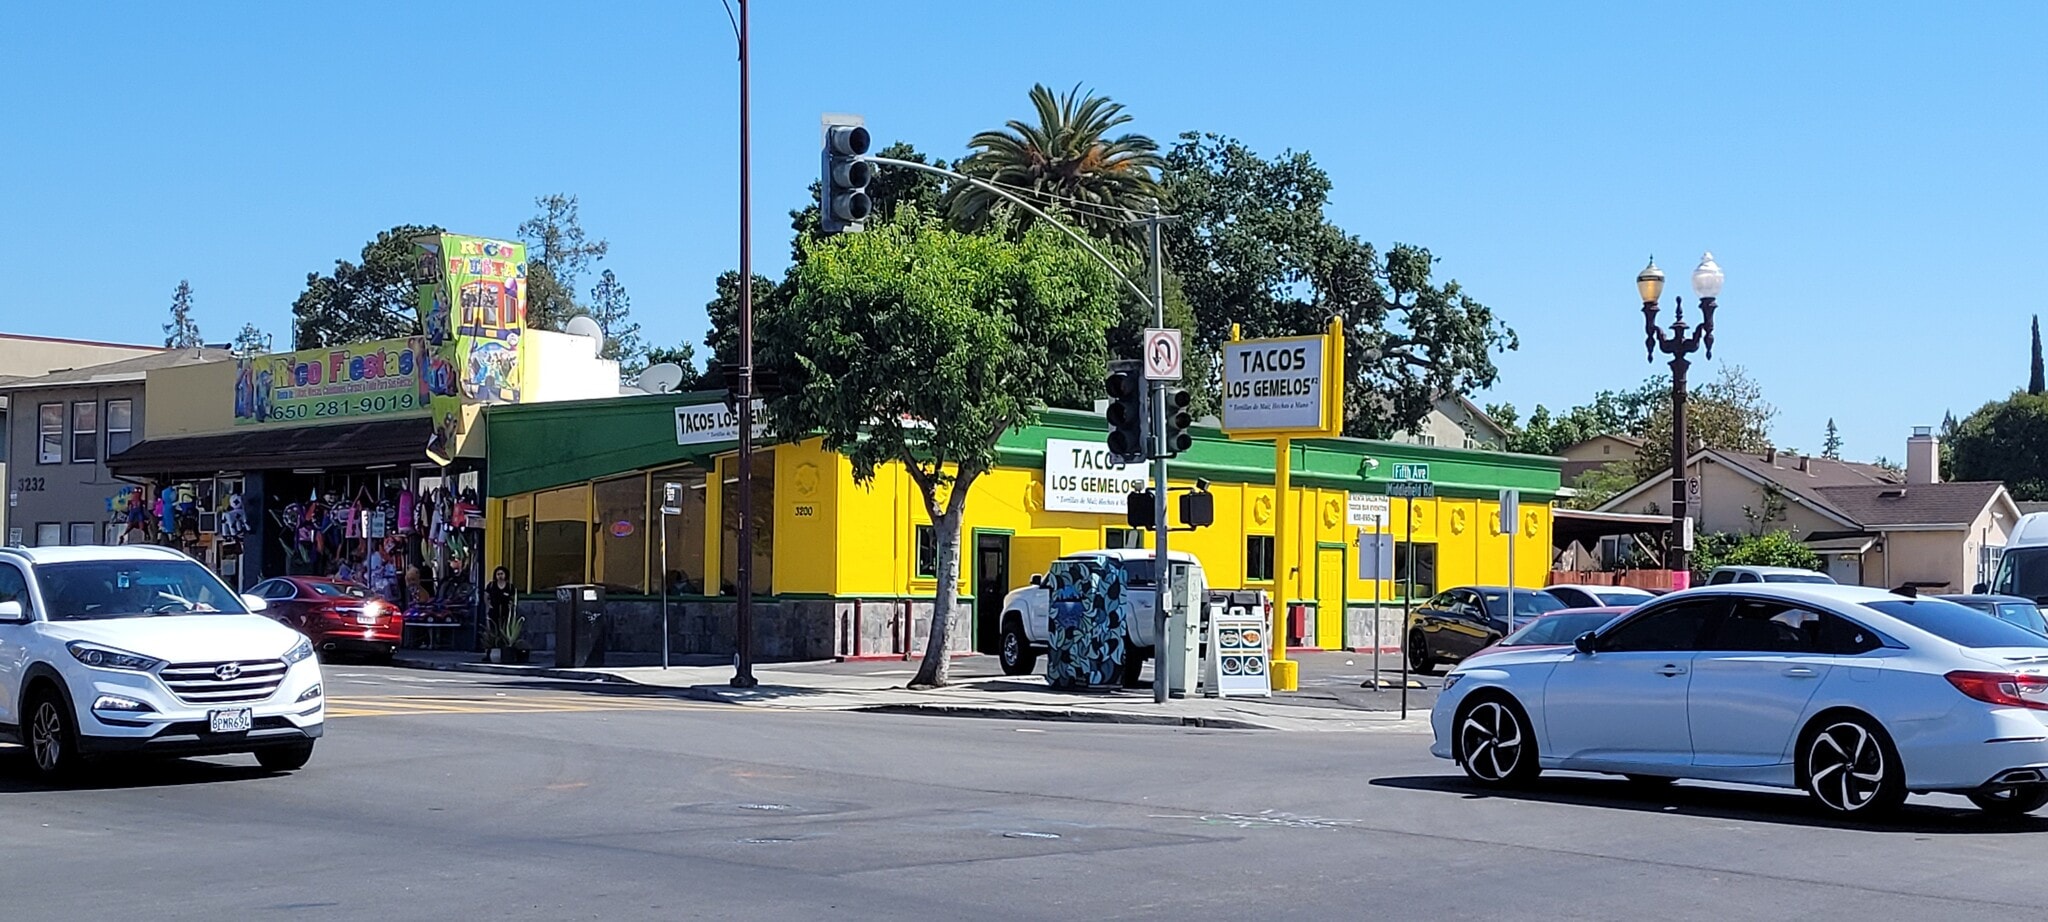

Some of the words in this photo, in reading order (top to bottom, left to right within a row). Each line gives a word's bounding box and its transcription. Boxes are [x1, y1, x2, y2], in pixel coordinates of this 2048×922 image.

[461, 241, 513, 258] RICO
[450, 258, 526, 278] FIESTAS
[274, 357, 322, 389] Rico
[329, 347, 414, 383] Fiestas
[1240, 347, 1305, 373] TACOS
[1227, 381, 1250, 398] LOS
[273, 404, 307, 420] 650
[315, 394, 413, 416] 281-9019
[678, 412, 714, 435] TACOS
[717, 412, 739, 428] LOS
[1395, 465, 1411, 479] Fifth
[1413, 465, 1426, 479] Ave
[18, 477, 45, 492] 3232
[1052, 475, 1077, 491] LOS
[1386, 482, 1421, 497] Middlefield
[1423, 483, 1432, 497] Rd
[795, 506, 813, 516] 3200
